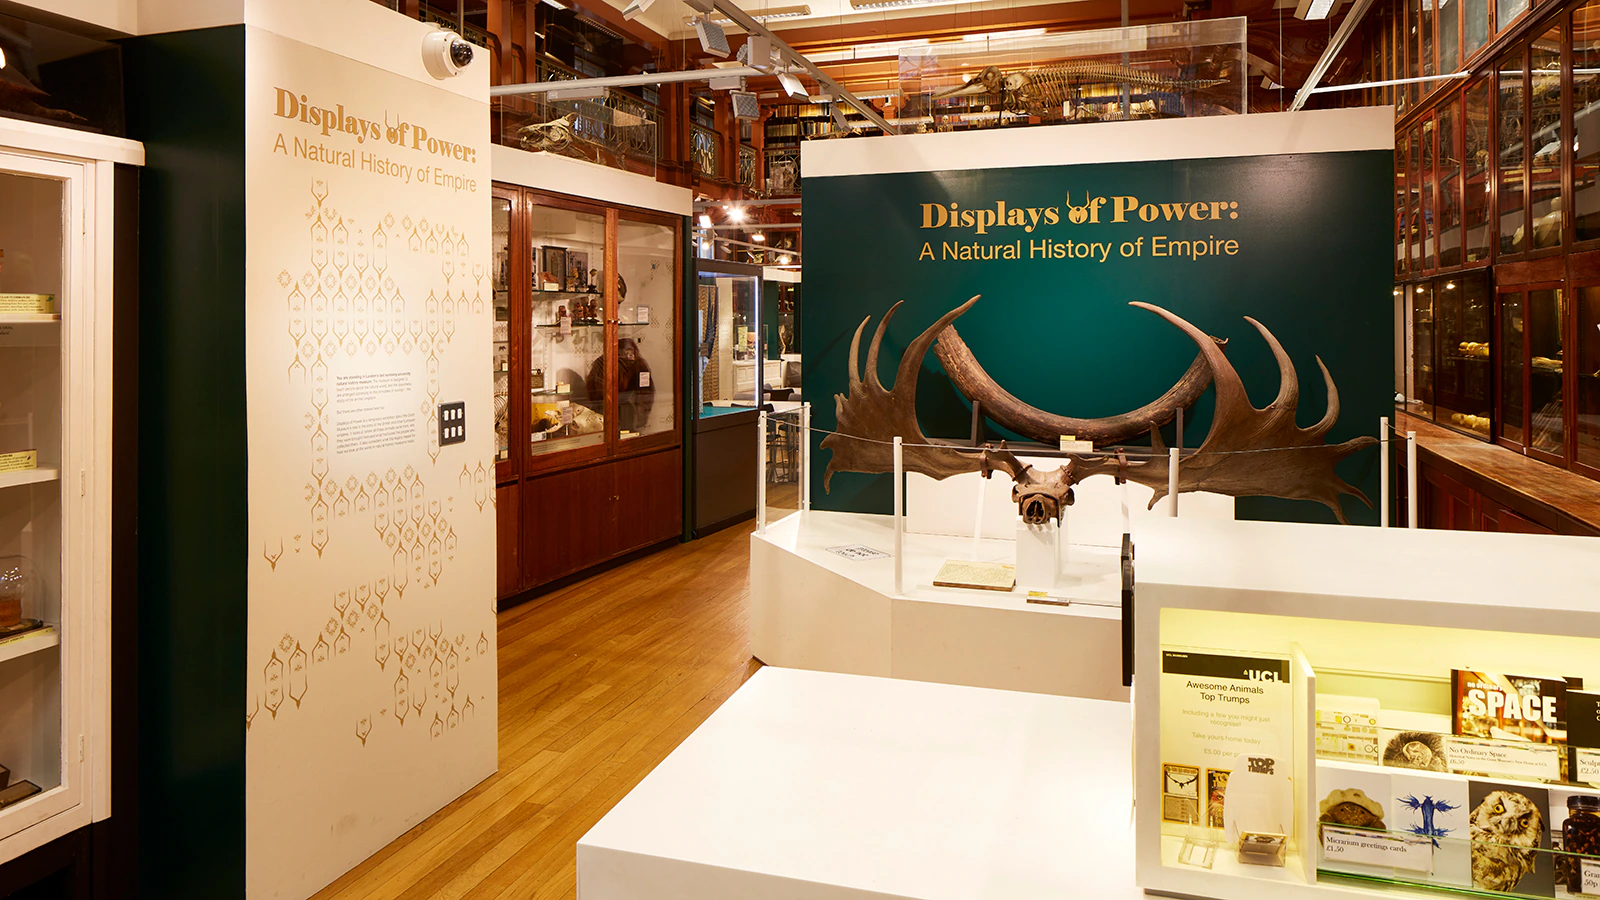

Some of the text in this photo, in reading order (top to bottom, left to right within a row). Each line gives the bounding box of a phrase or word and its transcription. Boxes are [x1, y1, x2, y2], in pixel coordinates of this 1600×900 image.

[274, 87, 476, 163] Displays of Power:
[274, 133, 476, 193] A Natural History of Empire
[920, 193, 1239, 234] Displays of Power:
[919, 235, 1239, 262] A Natural History of Empire
[1248, 670, 1283, 683] UCL
[1186, 681, 1264, 694] Awesome Animals
[1200, 692, 1250, 704] Top Trumps
[1183, 709, 1209, 718] Including
[1468, 689, 1557, 723] SPACE
[1248, 757, 1274, 768] TOP
[1326, 836, 1407, 853] Micrarium greetings cards
[1584, 880, 1598, 888] 50p
